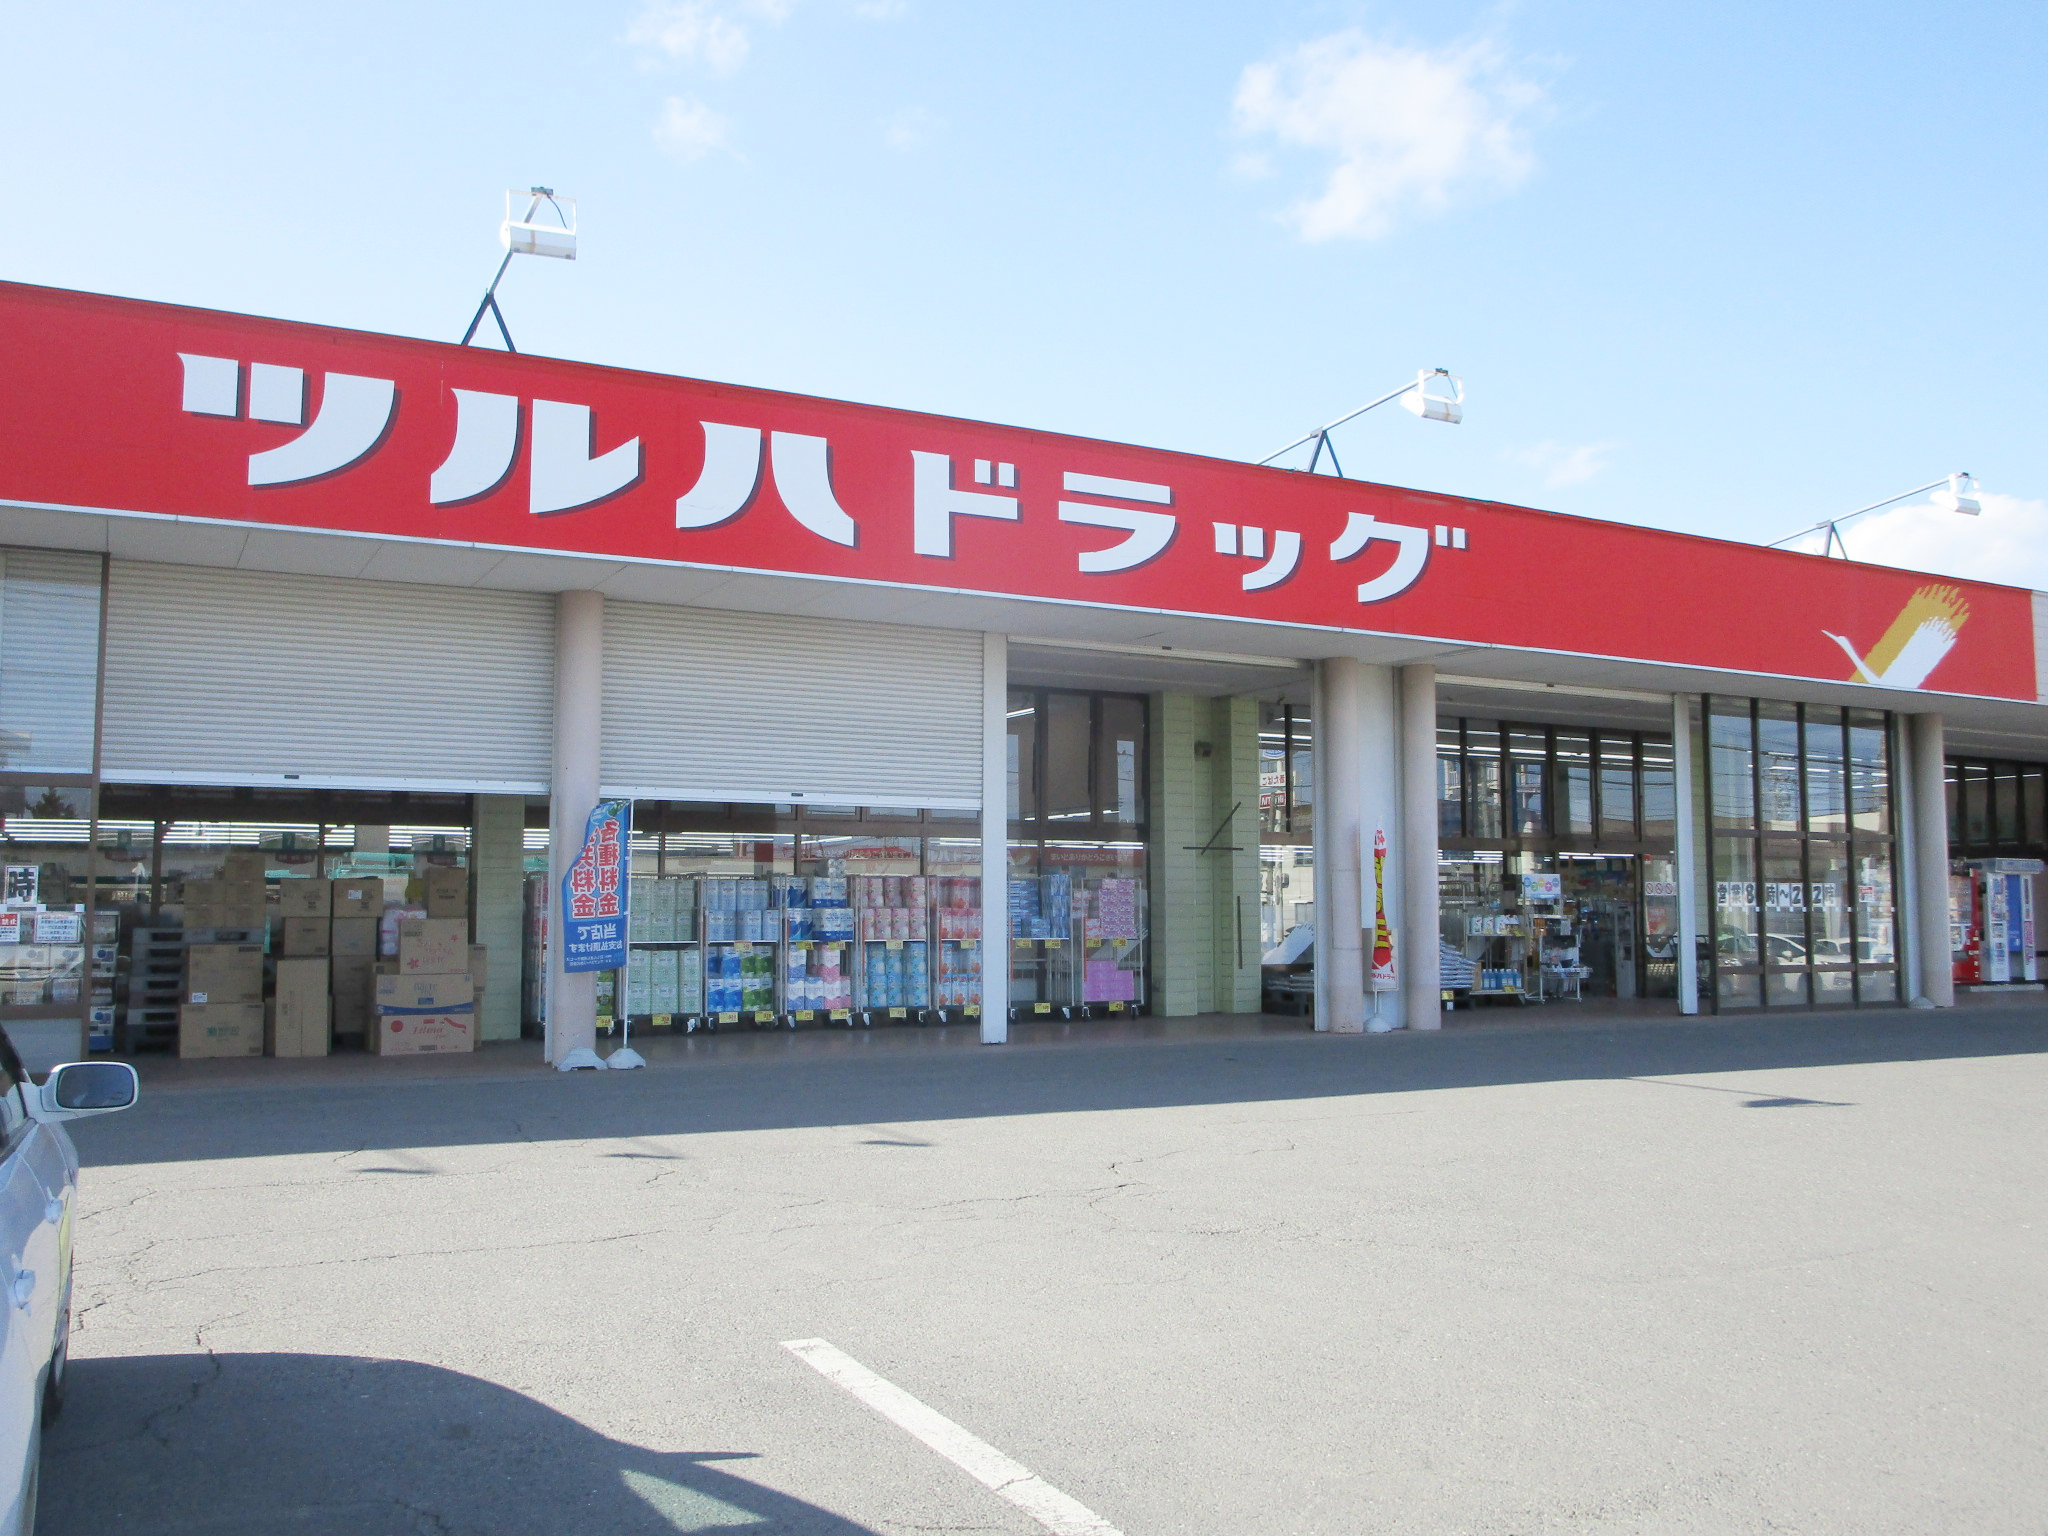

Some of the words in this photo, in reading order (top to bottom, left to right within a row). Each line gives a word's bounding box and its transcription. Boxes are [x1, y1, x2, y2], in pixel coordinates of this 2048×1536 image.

[176, 352, 1468, 604] ツルハドラッグ
[8, 869, 35, 902] 時
